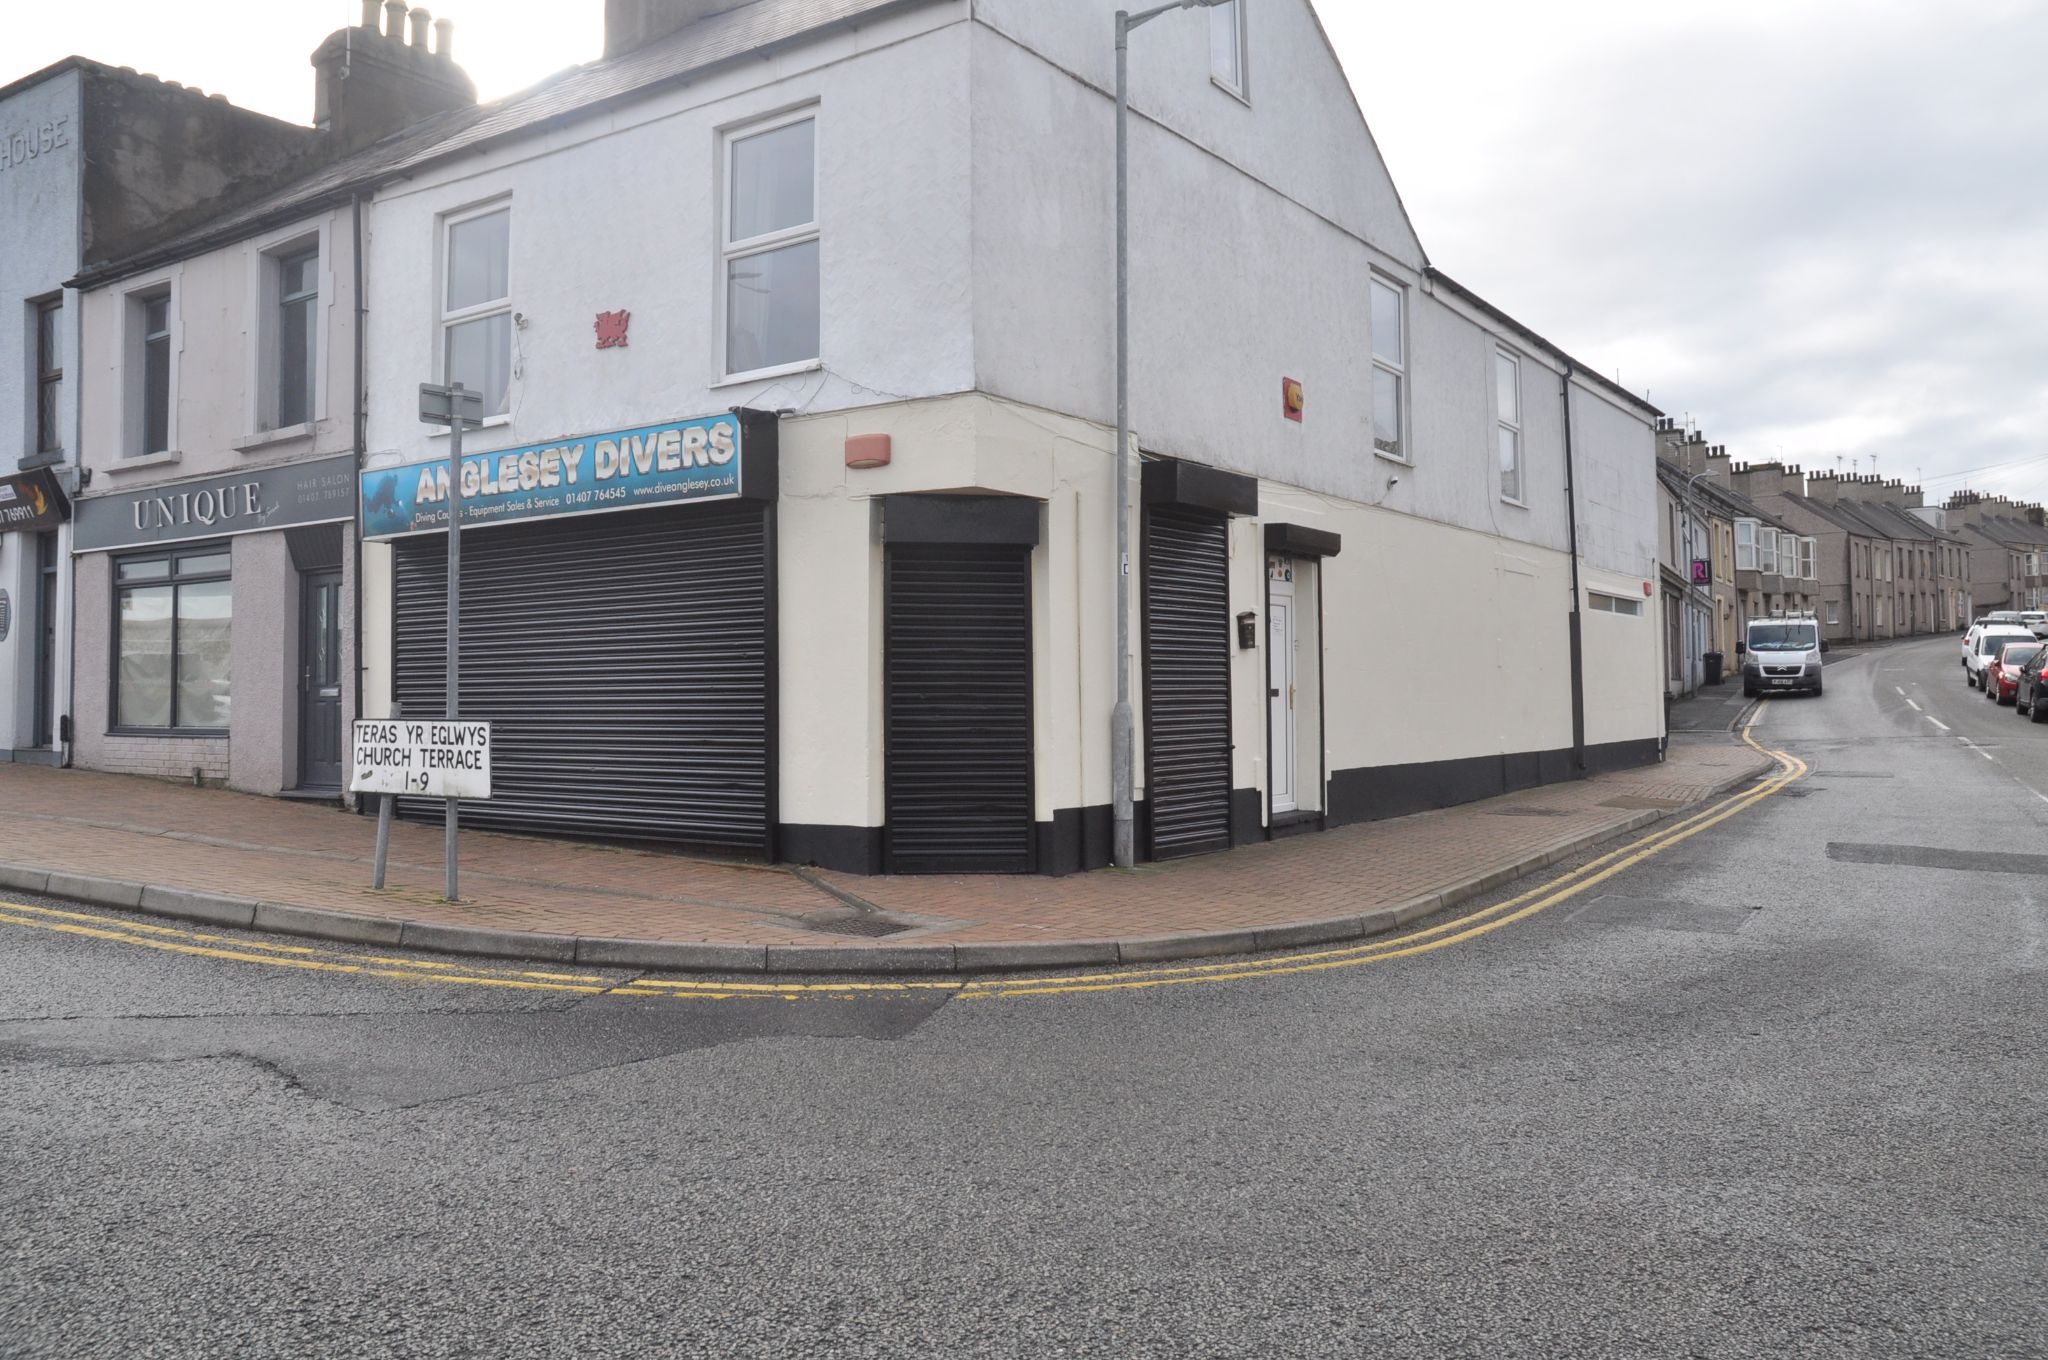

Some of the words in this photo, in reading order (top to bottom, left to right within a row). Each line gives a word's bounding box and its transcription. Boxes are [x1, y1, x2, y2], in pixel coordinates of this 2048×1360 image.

[415, 443, 586, 505] ANGLESEY
[594, 421, 735, 481] DIVERS
[297, 478, 317, 490] HAIR
[321, 473, 350, 487] SALON
[132, 482, 261, 530] UNIQUE
[415, 512, 436, 524] Diving
[469, 501, 505, 518] Equipment
[507, 500, 525, 511] Sales
[527, 498, 532, 509] &
[534, 496, 560, 507] Service
[566, 490, 592, 504] 01407
[594, 487, 626, 501] 764545
[633, 473, 735, 496] www.diveanglesey.co.uk
[3, 505, 35, 522] 769911
[356, 724, 398, 744] TERAS
[406, 724, 424, 744] YR
[431, 725, 487, 746] EGLWYS
[356, 747, 411, 767] CHURCH
[420, 748, 482, 770] TERRACE
[405, 770, 429, 791] 1-9
